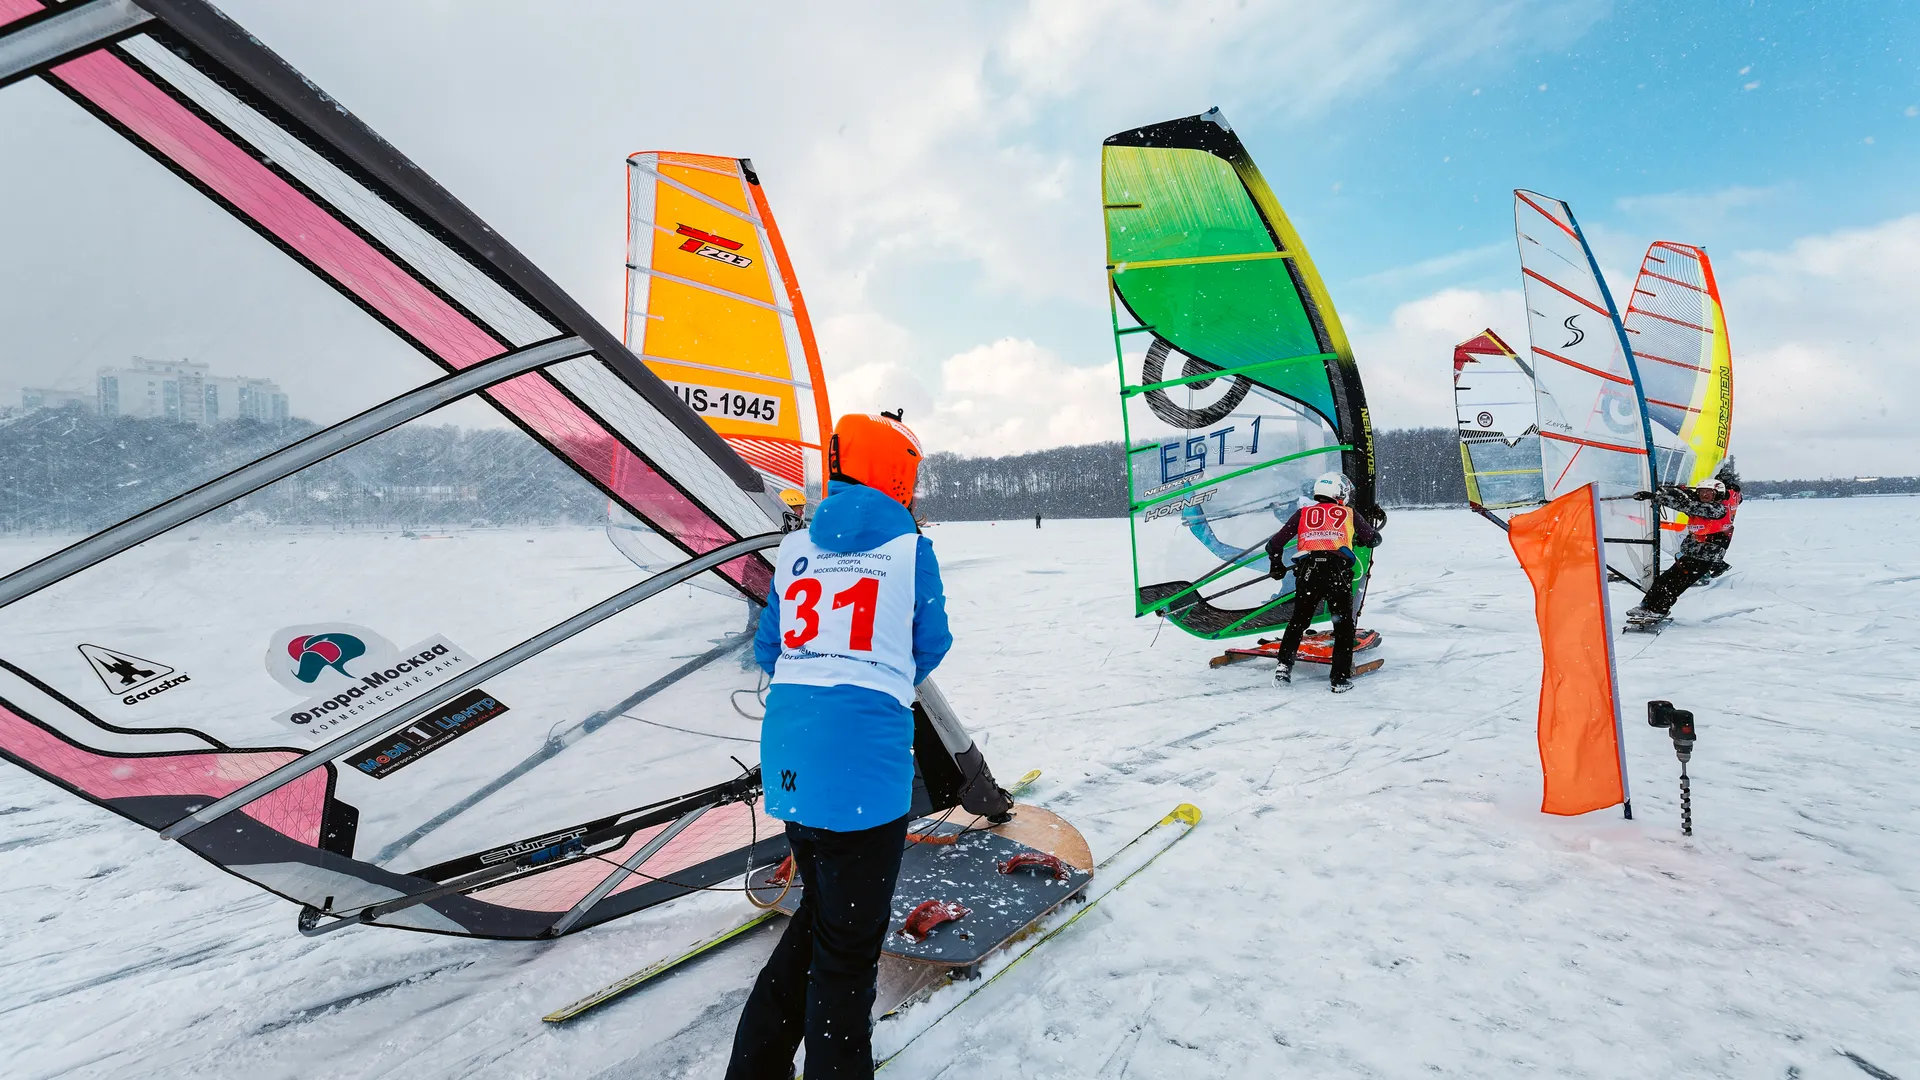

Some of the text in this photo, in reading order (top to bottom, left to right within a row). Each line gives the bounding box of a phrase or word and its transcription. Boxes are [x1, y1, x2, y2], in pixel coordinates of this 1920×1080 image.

[1716, 365, 1730, 449] NEILPRYDE
[1360, 407, 1375, 475] NEILPRYDE
[1144, 488, 1218, 523] HORNET
[1305, 506, 1348, 530] 09
[813, 565, 887, 578] МОСКОВСКОЙ ОБЛАСТИ
[816, 552, 892, 561] ФЕДЕРАЦИЯ ПАРУСНОГО
[783, 577, 880, 652] 31
[122, 674, 191, 706] Gaastra
[290, 642, 450, 725] Флора-Москва
[310, 655, 462, 735] КОММЕРЧЕСКИЙ БАНК
[357, 742, 412, 773] Mobil
